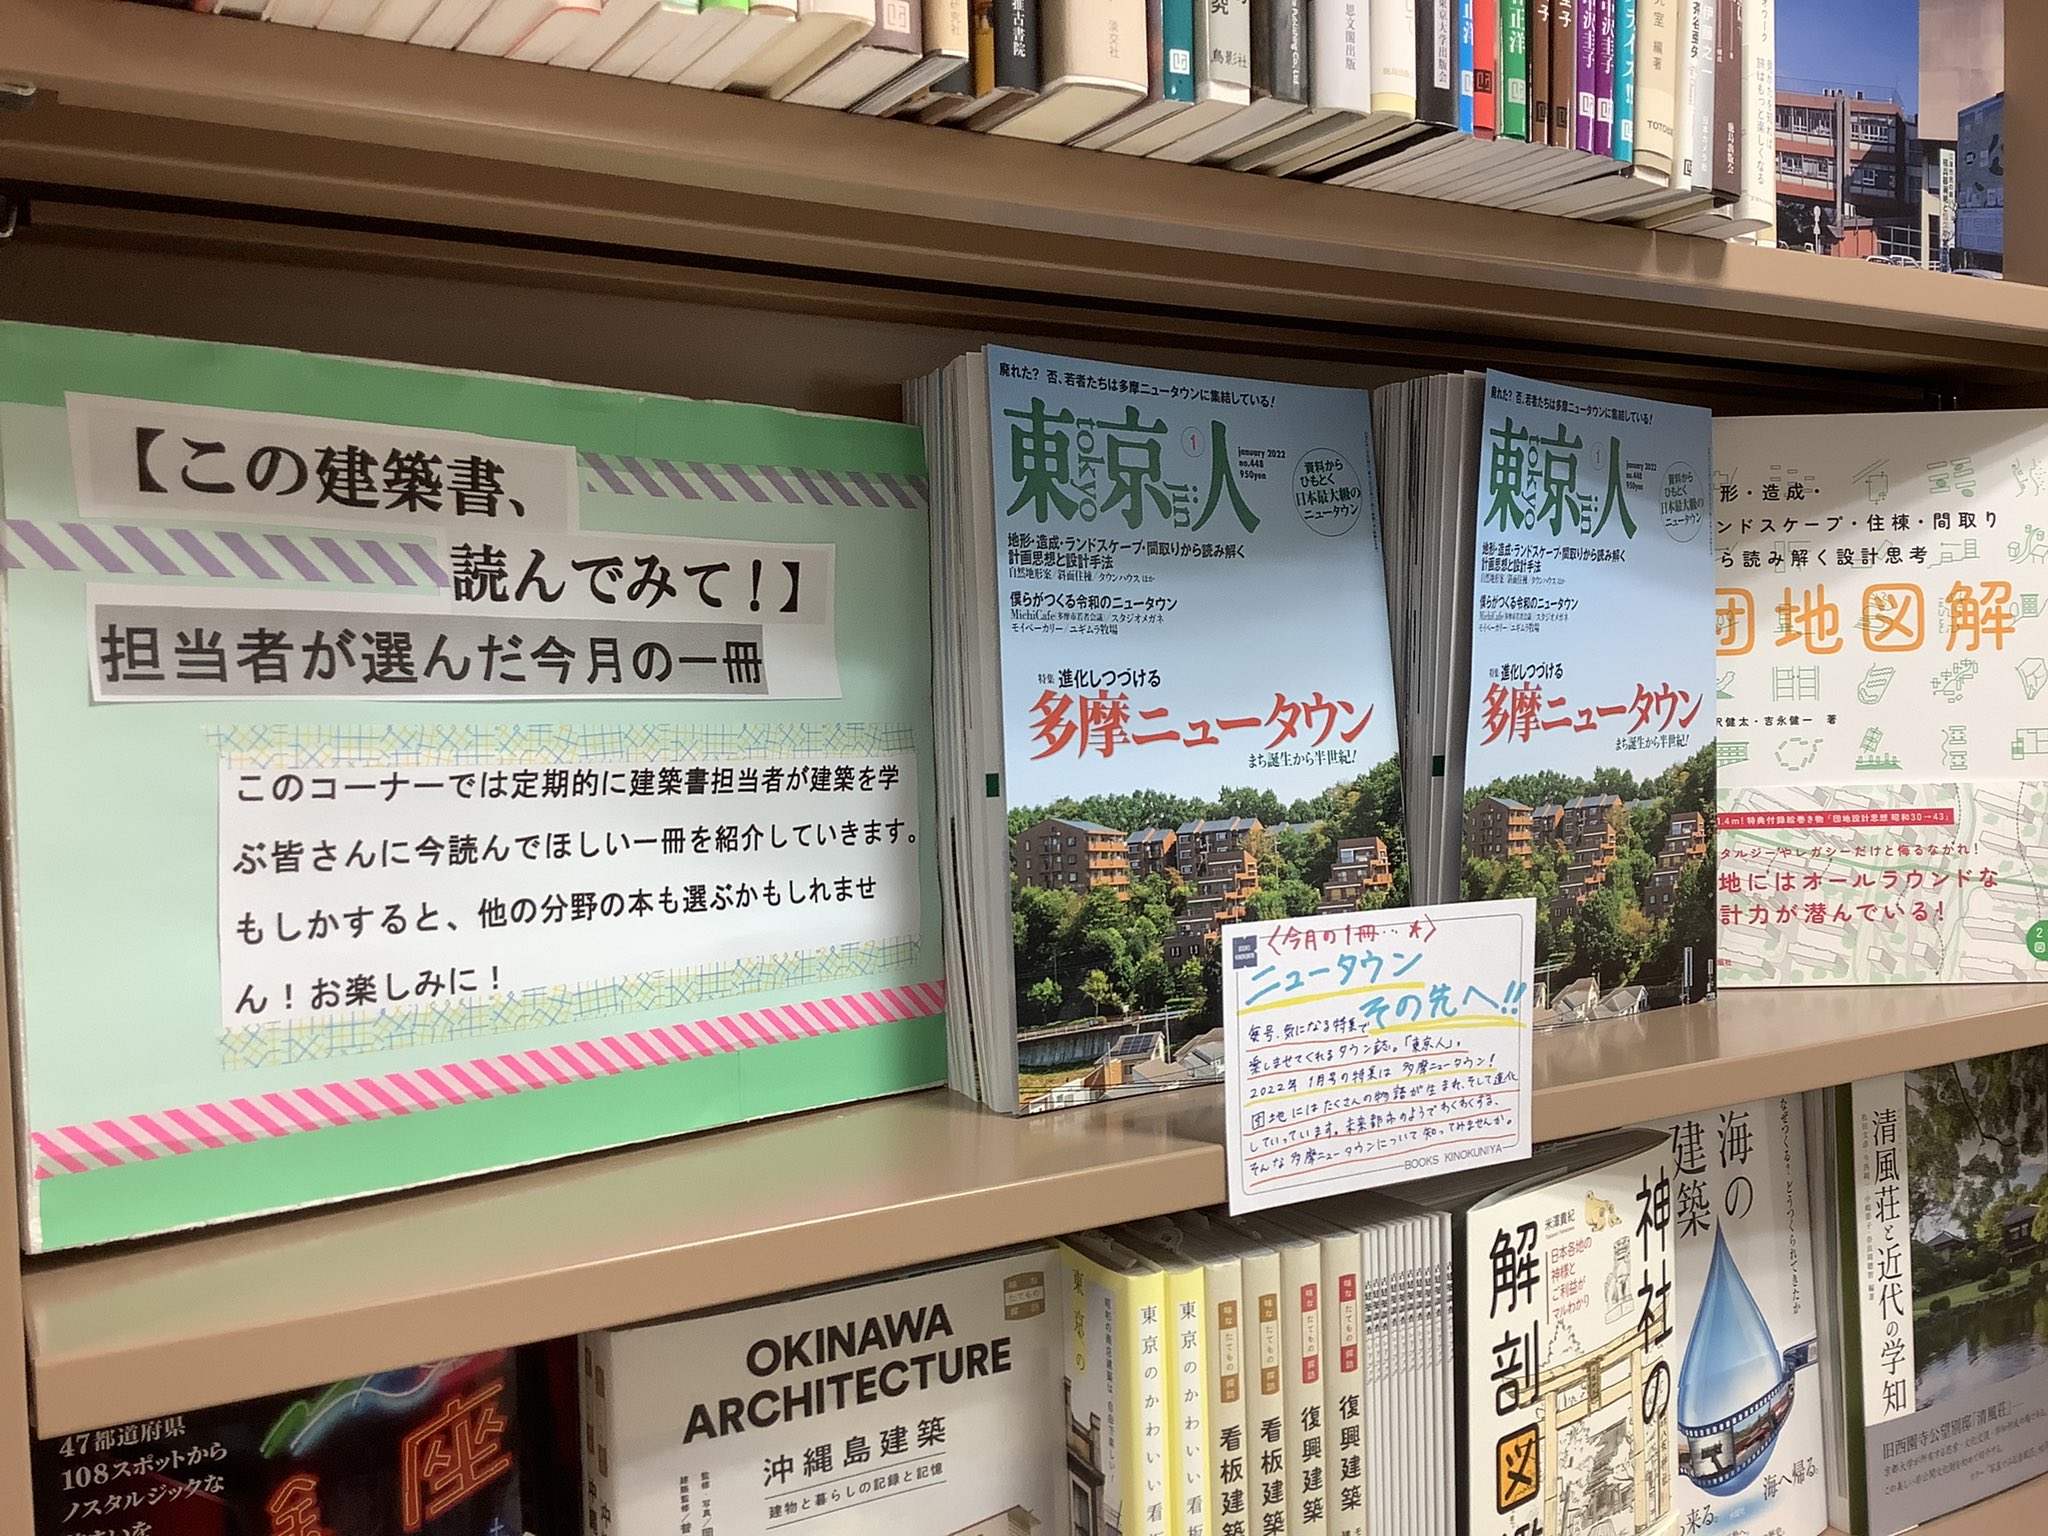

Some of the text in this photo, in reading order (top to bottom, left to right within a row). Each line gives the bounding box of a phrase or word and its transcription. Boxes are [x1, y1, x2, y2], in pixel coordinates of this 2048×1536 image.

[134, 426, 530, 520] 【この建築書、
[1003, 396, 1261, 534] 東京人
[1070, 417, 1106, 524] tokyo
[1267, 449, 1286, 459] 2022
[1304, 458, 1344, 474] 資料から
[1484, 416, 1638, 540] 東京人
[1162, 480, 1200, 530] jin
[1295, 486, 1361, 508] 日本最大級の
[1300, 473, 1336, 487] ひもとく
[1523, 435, 1543, 530] tokyo
[1302, 503, 1359, 522] ニュータウン
[1576, 492, 1599, 535] jin
[1007, 532, 1246, 560] 地形・造成・ランドスケープ・間取りから読み解く
[1008, 550, 1114, 571] 計画思想と設計手法
[1721, 546, 1929, 569] ら読み解く設計思考
[451, 543, 802, 615] 読んでみて！】
[1010, 591, 1179, 612] 僕らがつくる令和のニュータウン
[100, 620, 763, 687] 担当者が選んだ今月の一冊
[1038, 668, 1162, 689] 特集 進化しつづける
[1500, 662, 1564, 682] 進化しつづける
[1029, 688, 1375, 761] 多摩ニュータウン
[1480, 681, 1704, 747] 多摩ニュータウン
[1827, 714, 1838, 726] 著
[237, 764, 901, 805] このコーナーでは定期的に建築書担当者が建築を学
[233, 817, 920, 876] ぶ皆さんに今読んでほしい一冊を紹介していきます。
[1719, 867, 1999, 892] 地にはオールラウンドな
[236, 875, 877, 946] もしかすると、他の分野の本も選ぶかもしれませ
[1721, 901, 1945, 926] 計力が潜んでいる！
[234, 965, 502, 1017] ん！お楽しみに！
[1245, 950, 1423, 1006] ニュータウン
[1404, 1144, 1503, 1170] BOOKS KINOKUNIYA
[1668, 1120, 1712, 1240] 建築
[1717, 1110, 1755, 1220] 海の
[1551, 1237, 1593, 1264] 日本各地の
[1552, 1262, 1576, 1284] 神様と
[1871, 1107, 1908, 1417] 清風荘と近代の学知
[1552, 1275, 1587, 1302] ご利益が
[1552, 1294, 1590, 1320] マルわかり
[1636, 1165, 1674, 1425] 神社の
[746, 1303, 954, 1378] OKINAWA
[682, 1336, 1013, 1444] ARCHITECTURE
[58, 1416, 186, 1458] 47都道府県
[763, 1416, 946, 1487] 沖縄島建築
[1339, 1394, 1362, 1512] 復興建築
[61, 1442, 228, 1491] 108スポットから
[768, 1461, 944, 1519] 建物と暮らしの記録と記憶
[1260, 1416, 1285, 1536] 看板建築
[1301, 1405, 1324, 1525] 復興建築
[61, 1474, 225, 1524] ノスタルジックな
